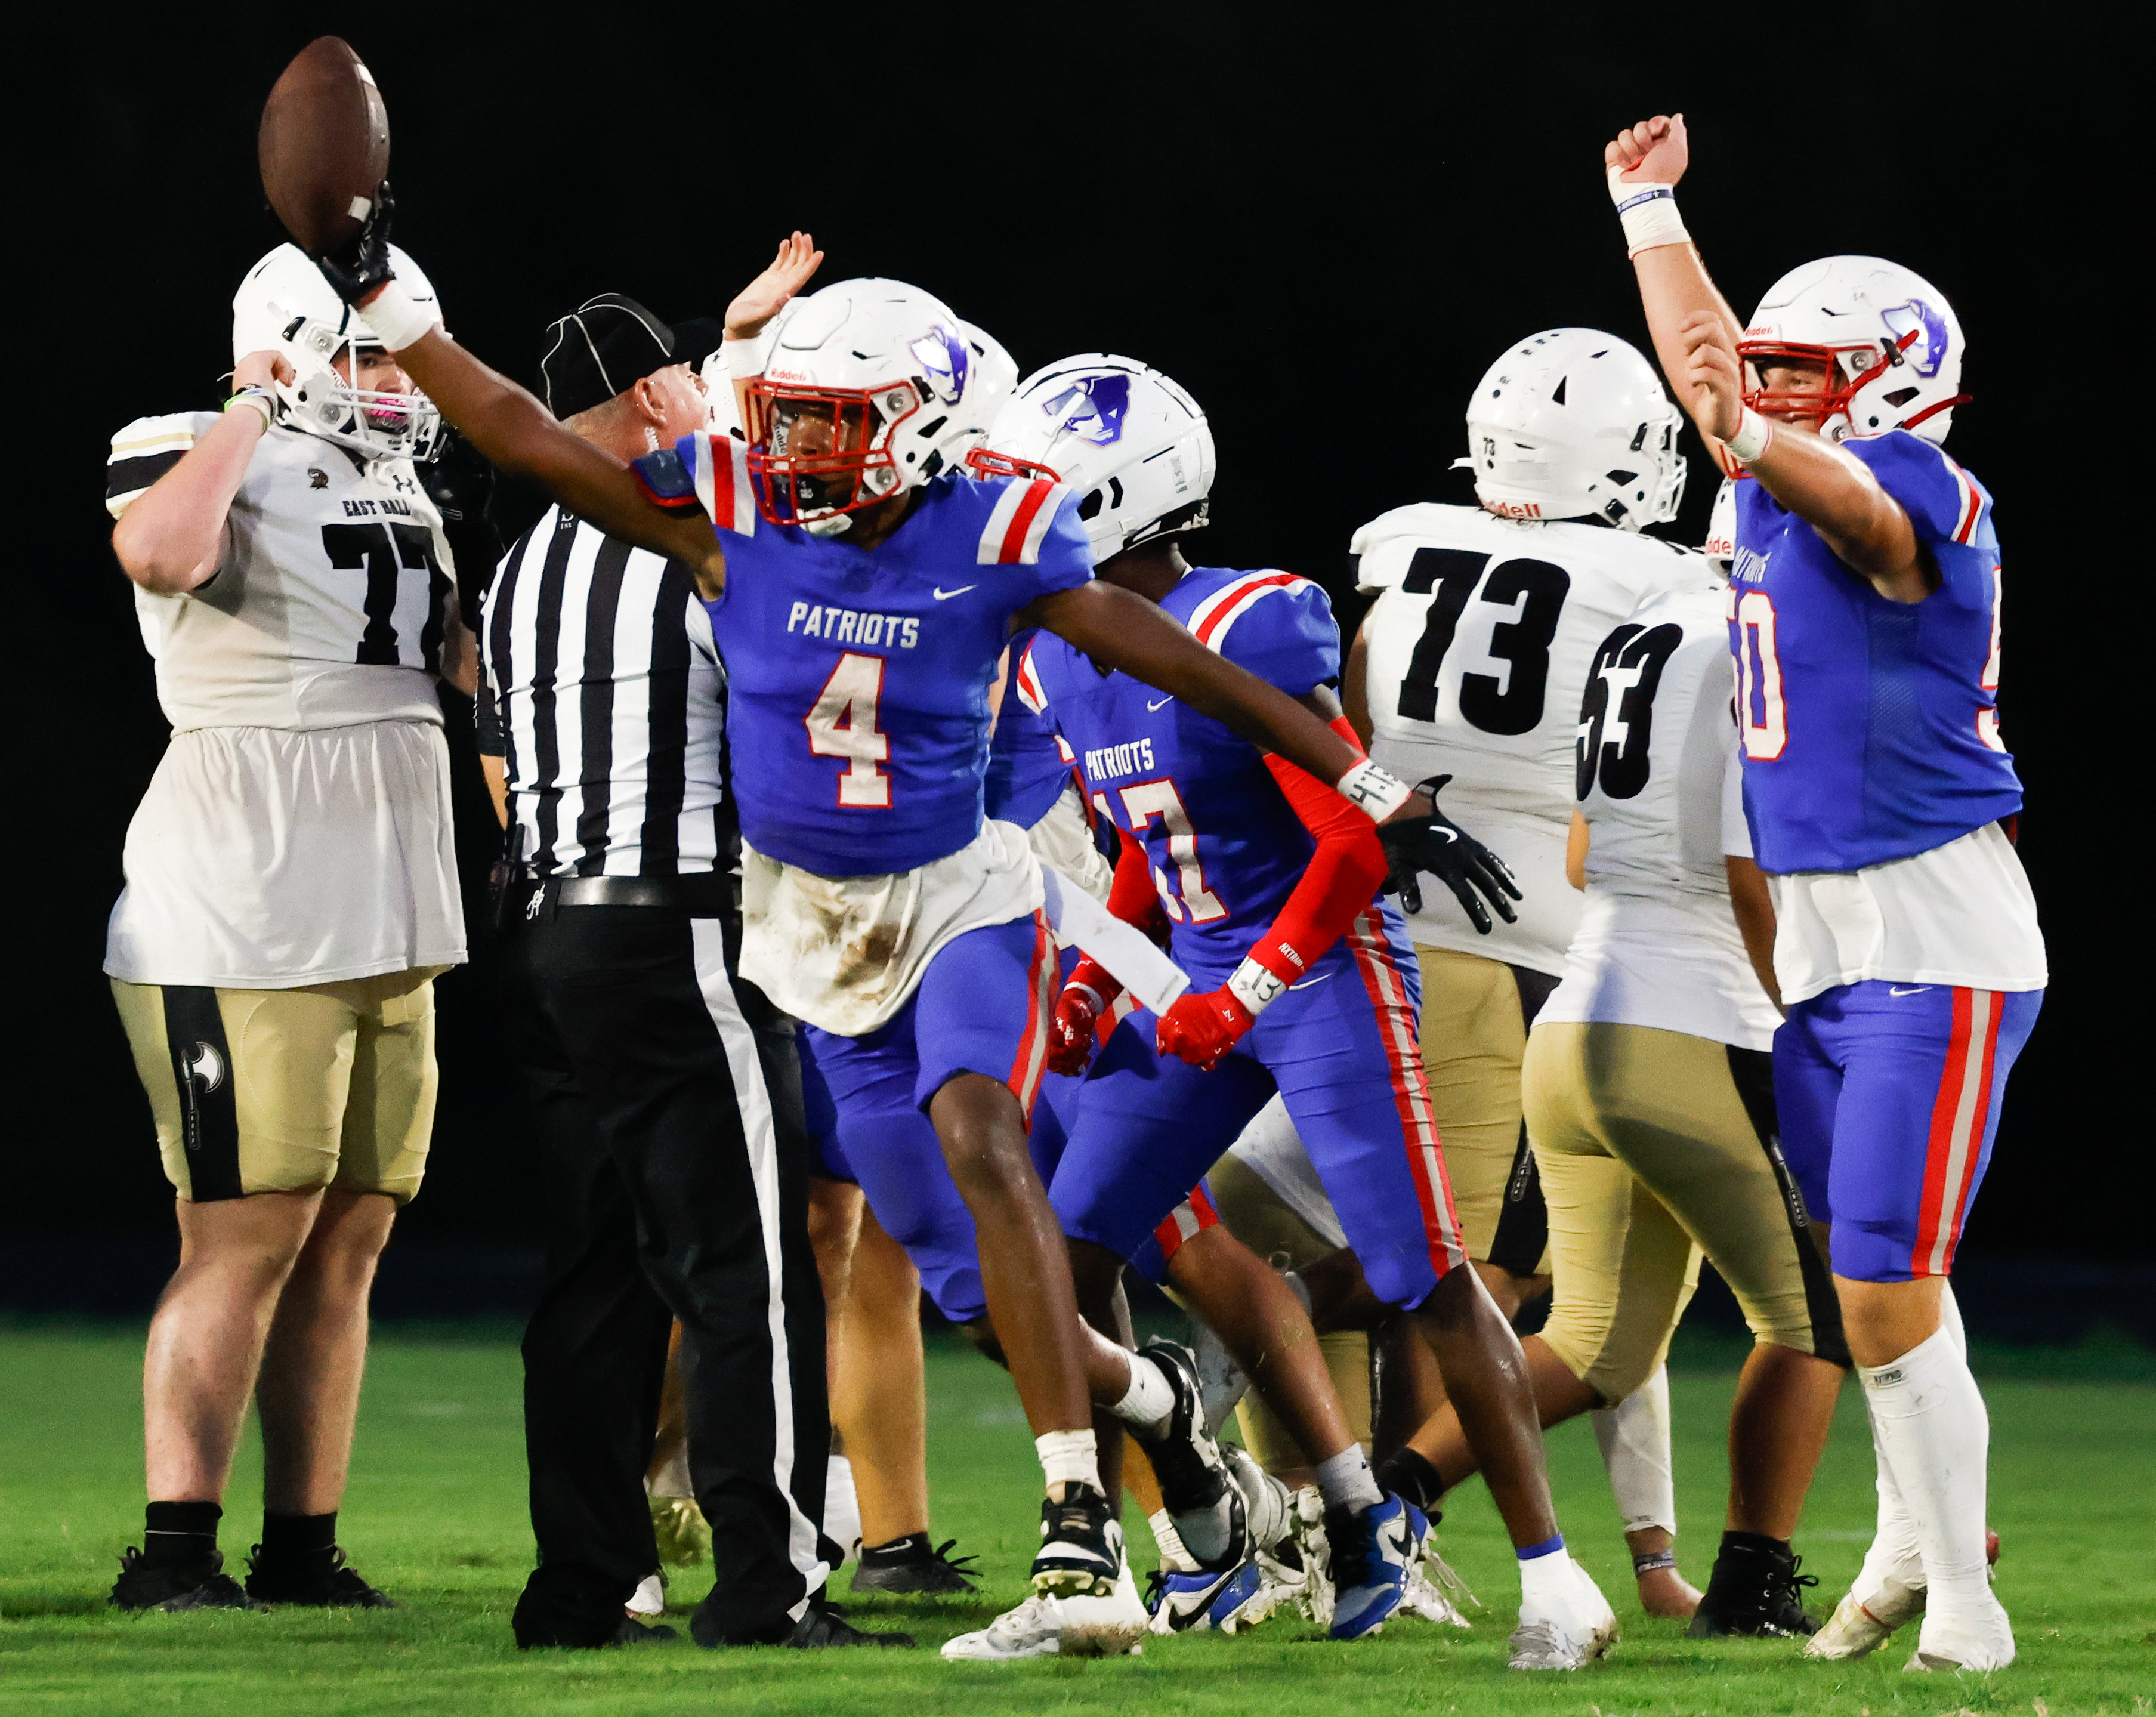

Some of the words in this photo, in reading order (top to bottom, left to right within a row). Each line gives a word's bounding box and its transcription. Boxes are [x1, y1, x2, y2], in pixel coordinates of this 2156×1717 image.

[342, 499, 377, 517] EAST
[322, 521, 451, 675] 77
[787, 601, 920, 649] PATRIOTS
[1398, 547, 1570, 736] 73
[802, 650, 894, 809] 4
[1085, 737, 1154, 782] PATRIOTS
